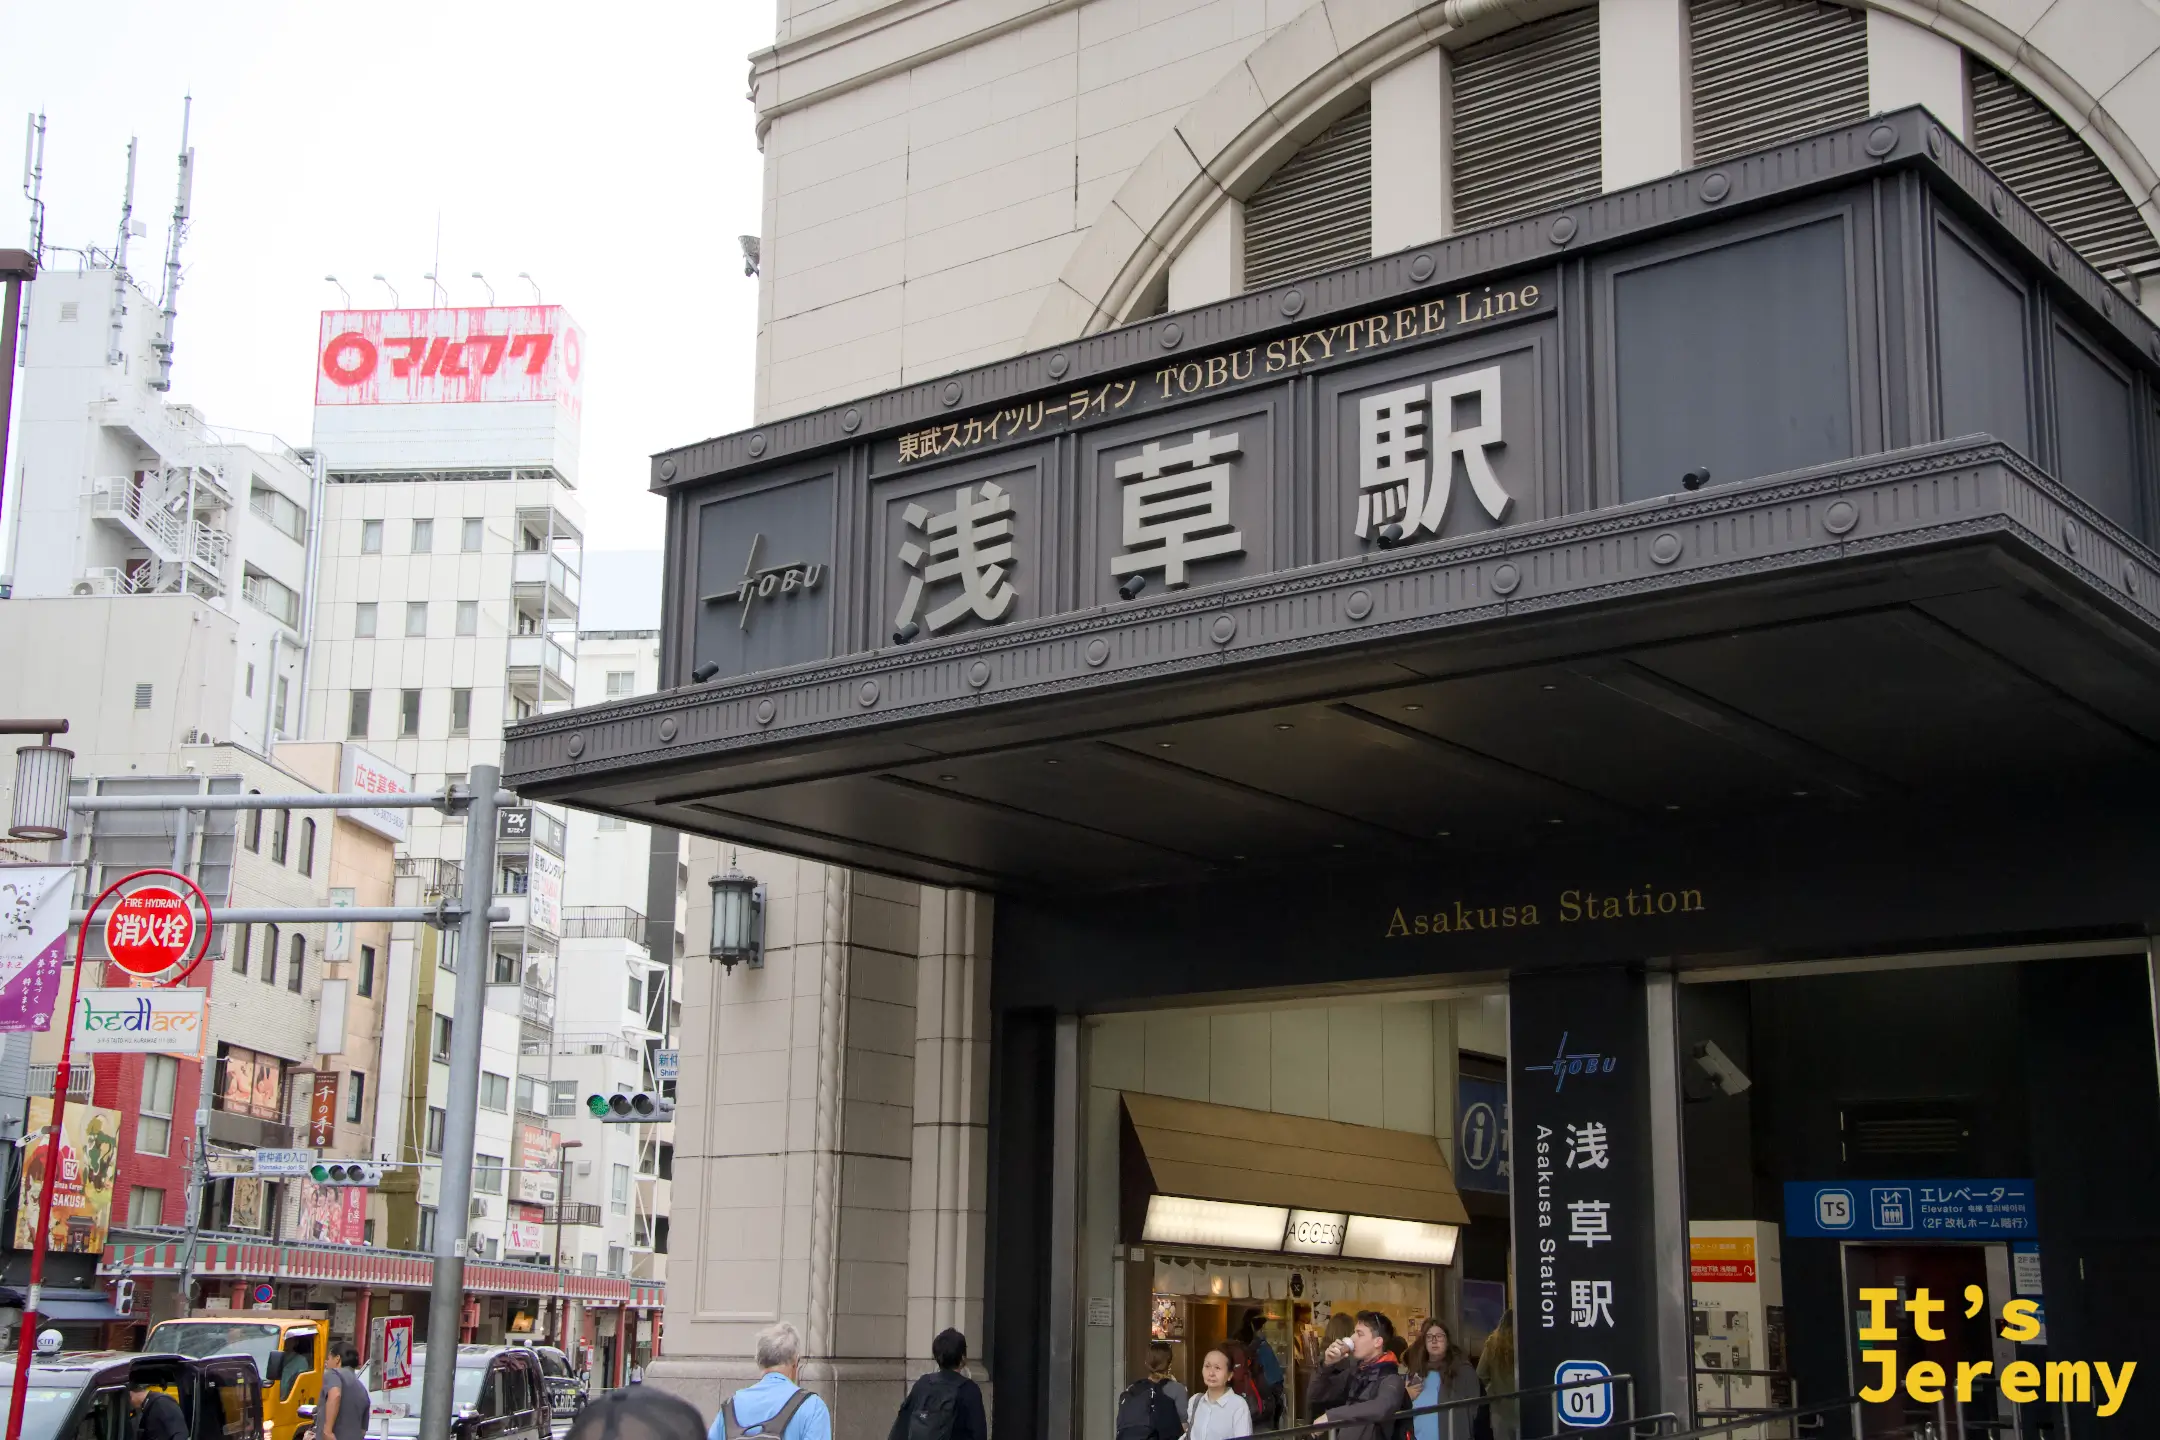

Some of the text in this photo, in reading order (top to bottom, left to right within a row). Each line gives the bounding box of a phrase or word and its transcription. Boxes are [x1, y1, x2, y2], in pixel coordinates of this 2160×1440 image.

[1156, 284, 1539, 399] TOBU SKYTREE Line
[897, 379, 1137, 464] 東武スカイツリーライン
[737, 563, 829, 602] TOBU
[125, 898, 181, 908] FIRE HYDRANT
[1385, 884, 1705, 937] Asakusa Station
[113, 914, 188, 948] 消火栓
[1552, 1056, 1616, 1076] TOBU
[64, 1161, 77, 1177] GK
[1920, 1188, 2025, 1202] エレベーター
[1823, 1202, 1846, 1217] TS
[1921, 1205, 1963, 1214] Elevator
[1286, 1221, 1344, 1245] ACCESS
[1537, 1125, 1557, 1328] Asakusa Station
[1564, 1122, 1614, 1328] 浅草駅
[1571, 1392, 1594, 1413] 01
